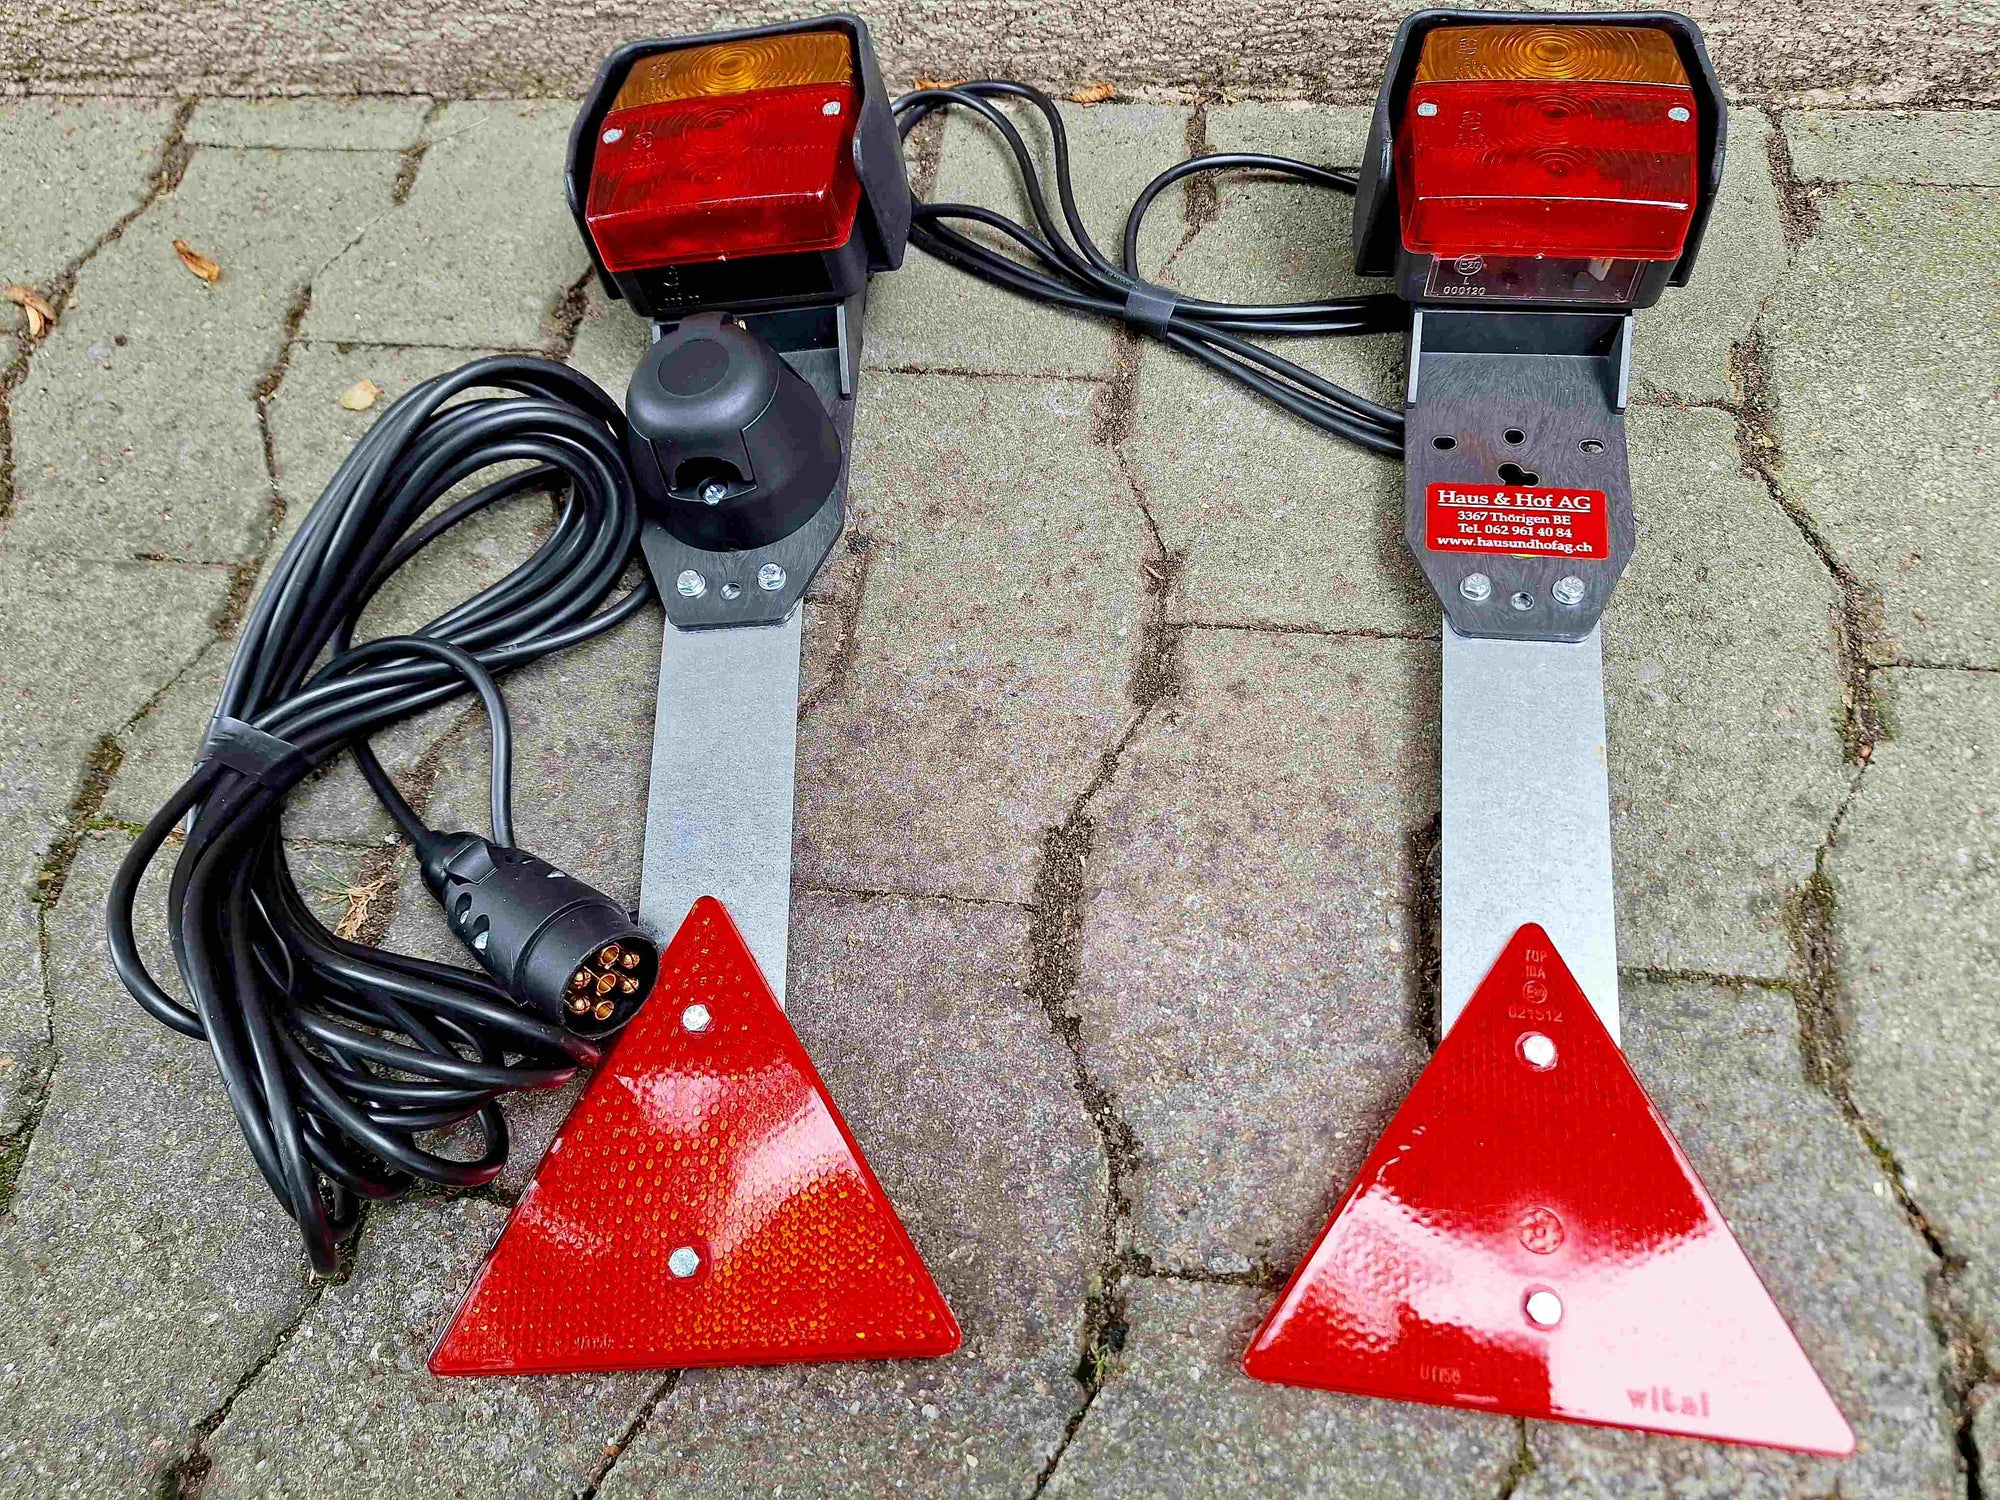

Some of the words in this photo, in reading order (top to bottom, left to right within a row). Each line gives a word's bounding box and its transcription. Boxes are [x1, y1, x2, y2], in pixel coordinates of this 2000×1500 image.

[1443, 286, 1486, 296] 000120
[1438, 490, 1489, 504] Haus
[1493, 492, 1511, 506] &
[1514, 493, 1553, 507] Hof
[1557, 495, 1591, 509] AG
[1457, 511, 1488, 521] 3367
[1489, 512, 1550, 526] Thörigen
[1553, 515, 1571, 525] BE
[1457, 523, 1482, 534] Tel.
[1484, 524, 1509, 535] 062
[1511, 526, 1534, 536] 961
[1537, 527, 1553, 537] 40
[1555, 527, 1572, 538] 84
[1436, 537, 1593, 554] www.hausundhofag.ch
